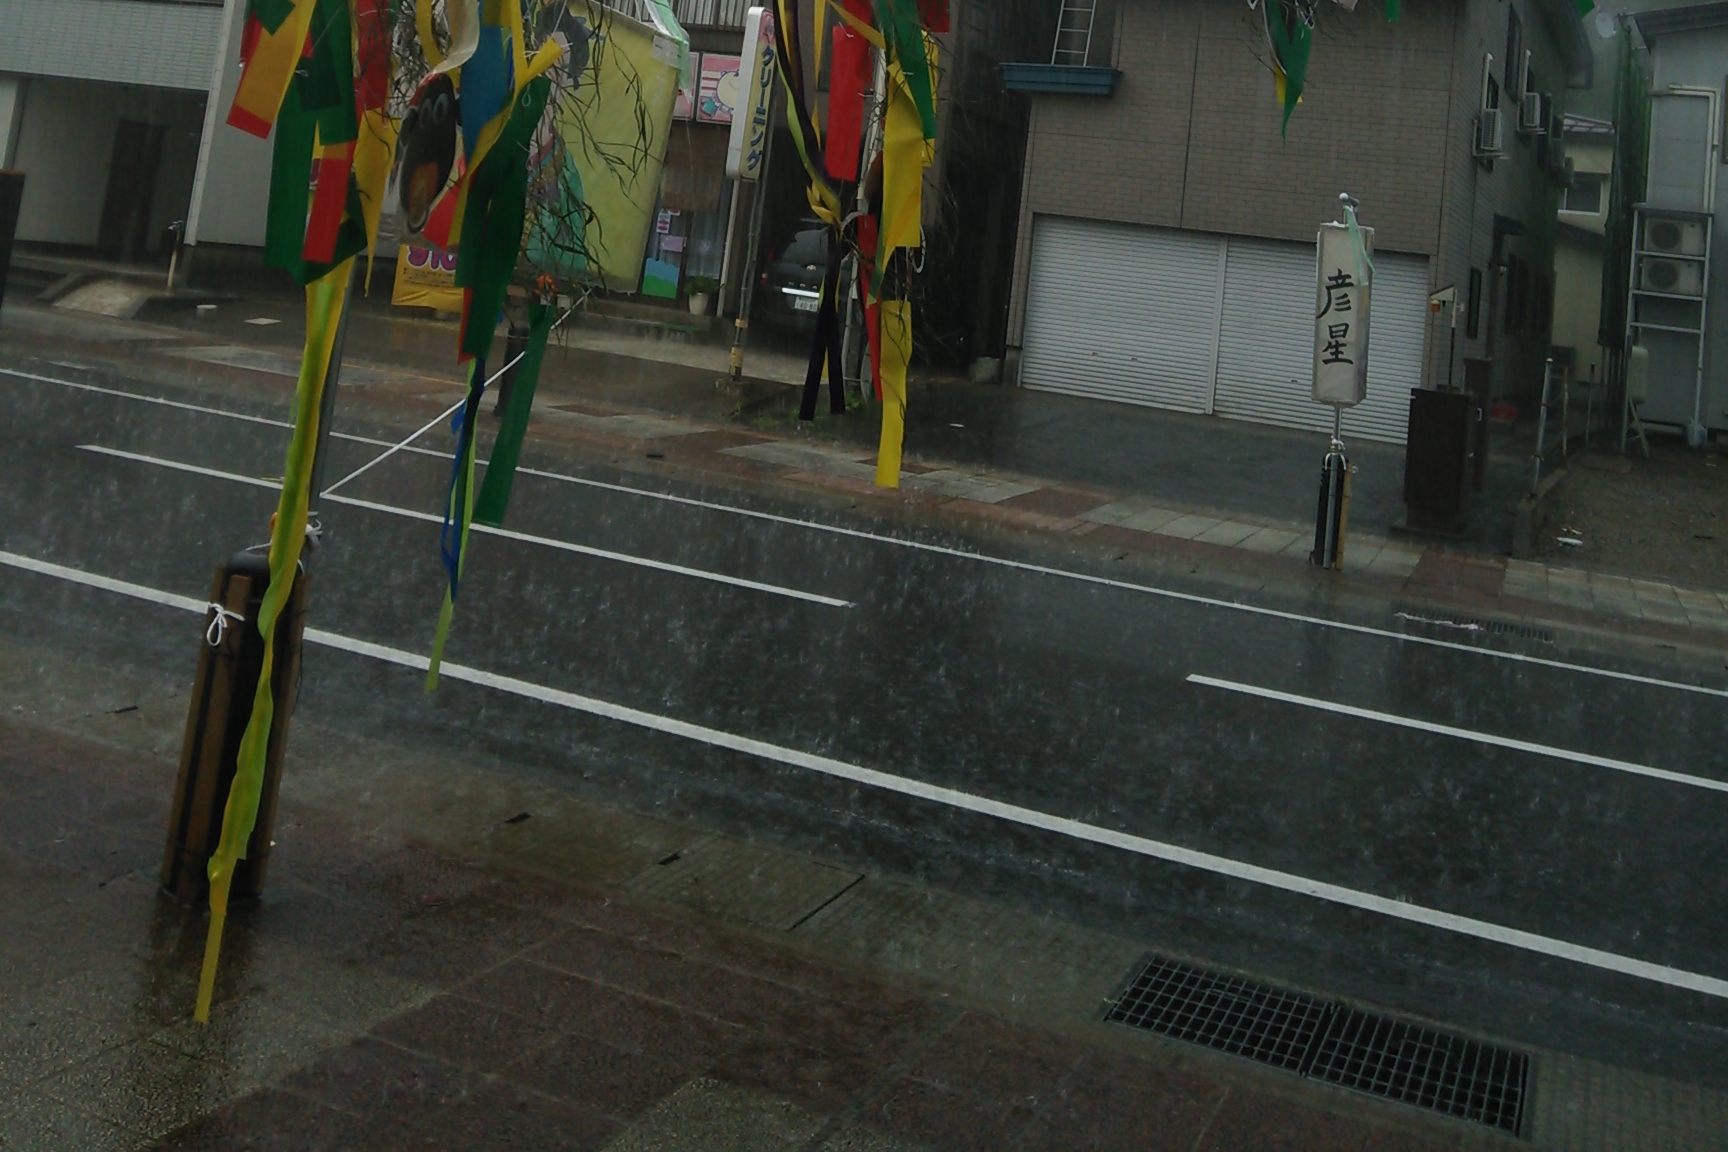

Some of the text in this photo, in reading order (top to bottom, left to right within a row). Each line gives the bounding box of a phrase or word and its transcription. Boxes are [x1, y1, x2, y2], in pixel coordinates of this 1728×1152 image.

[746, 44, 775, 171] クリーニング
